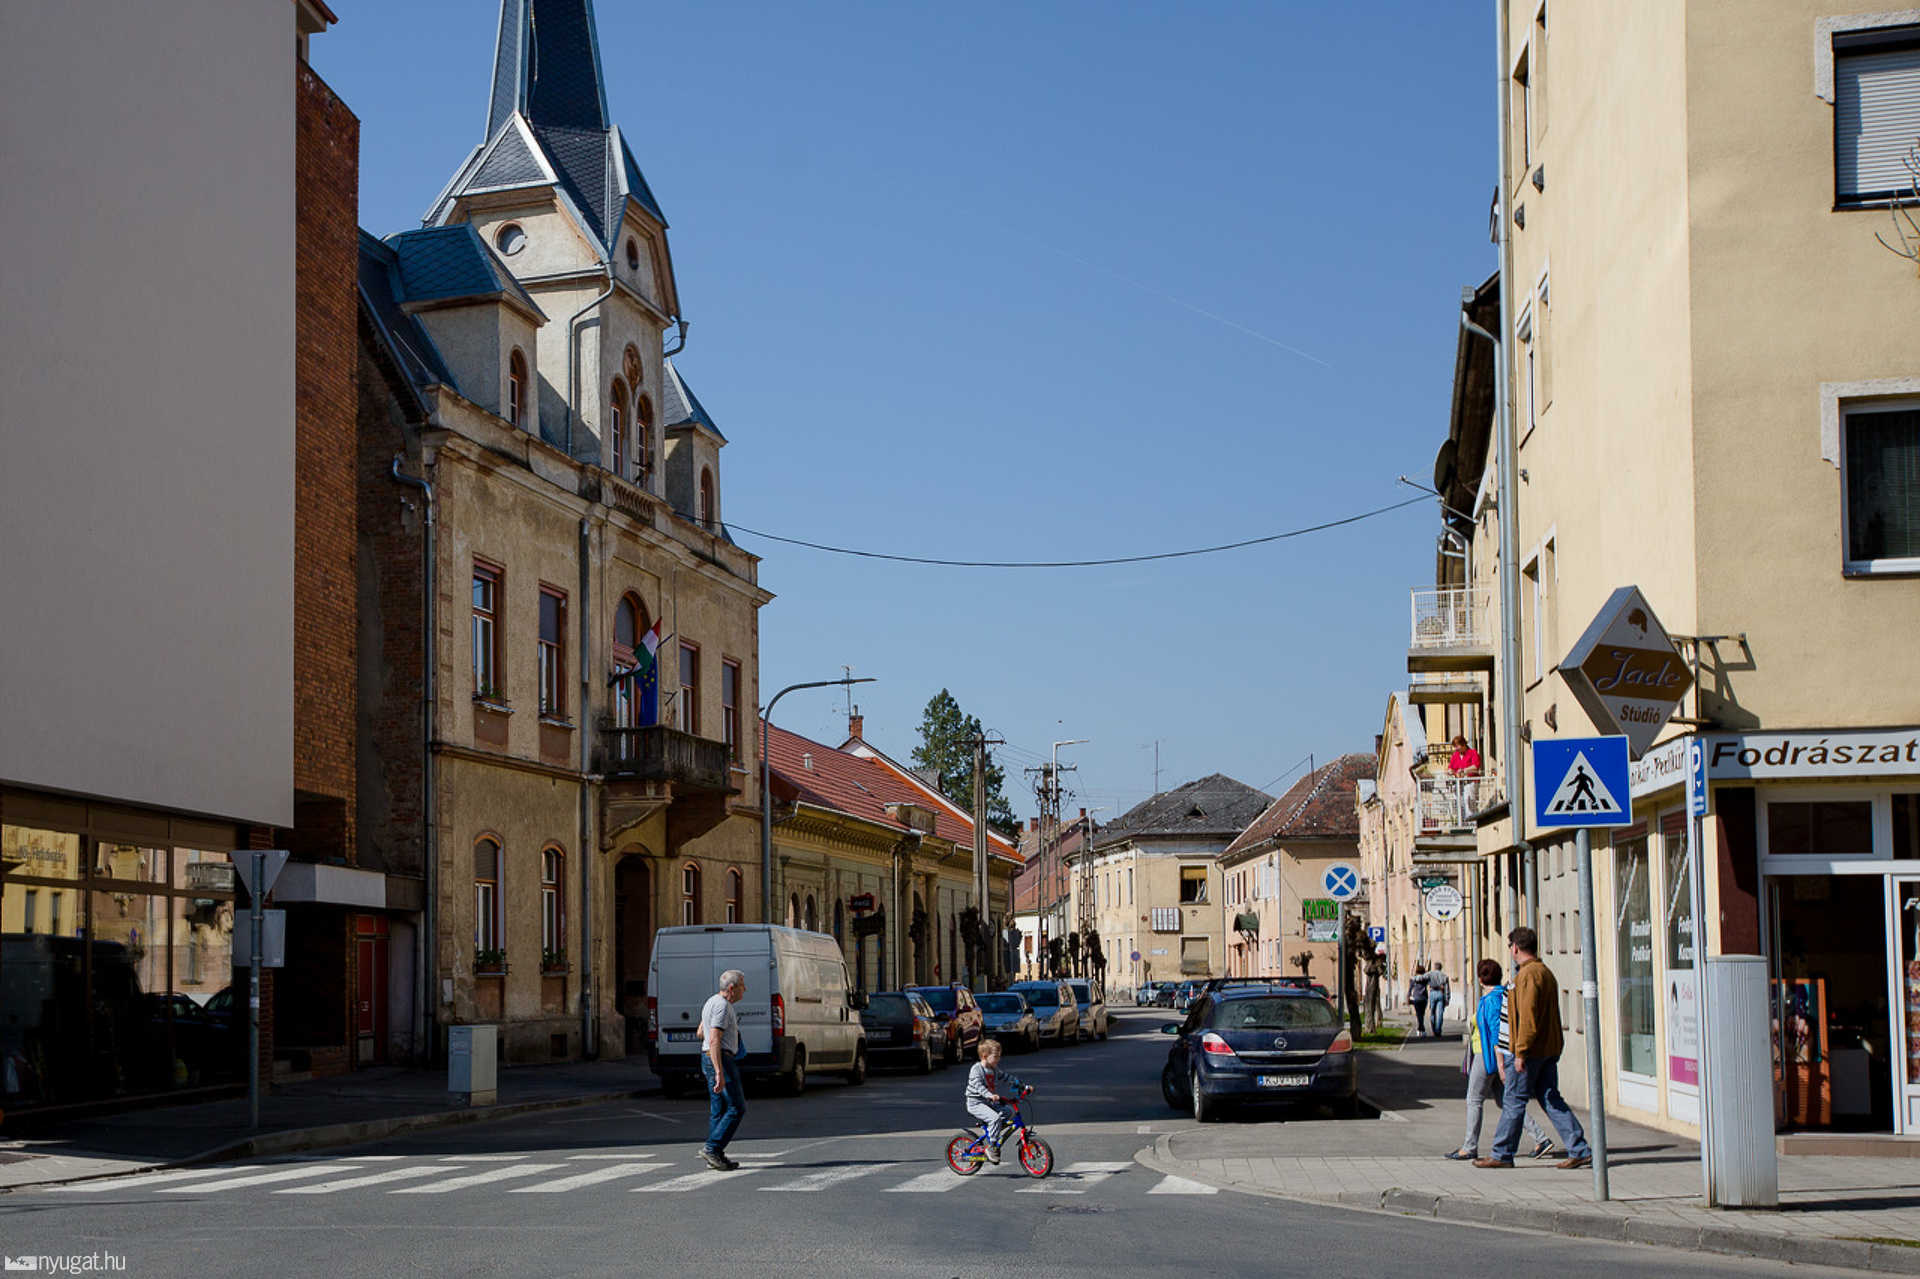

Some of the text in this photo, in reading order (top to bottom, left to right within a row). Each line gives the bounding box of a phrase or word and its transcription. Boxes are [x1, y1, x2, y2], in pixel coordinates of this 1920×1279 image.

[1594, 650, 1681, 690] Jade
[1621, 703, 1661, 724] Stúdió
[1711, 738, 1919, 768] Fodrászat
[1372, 928, 1381, 941] P
